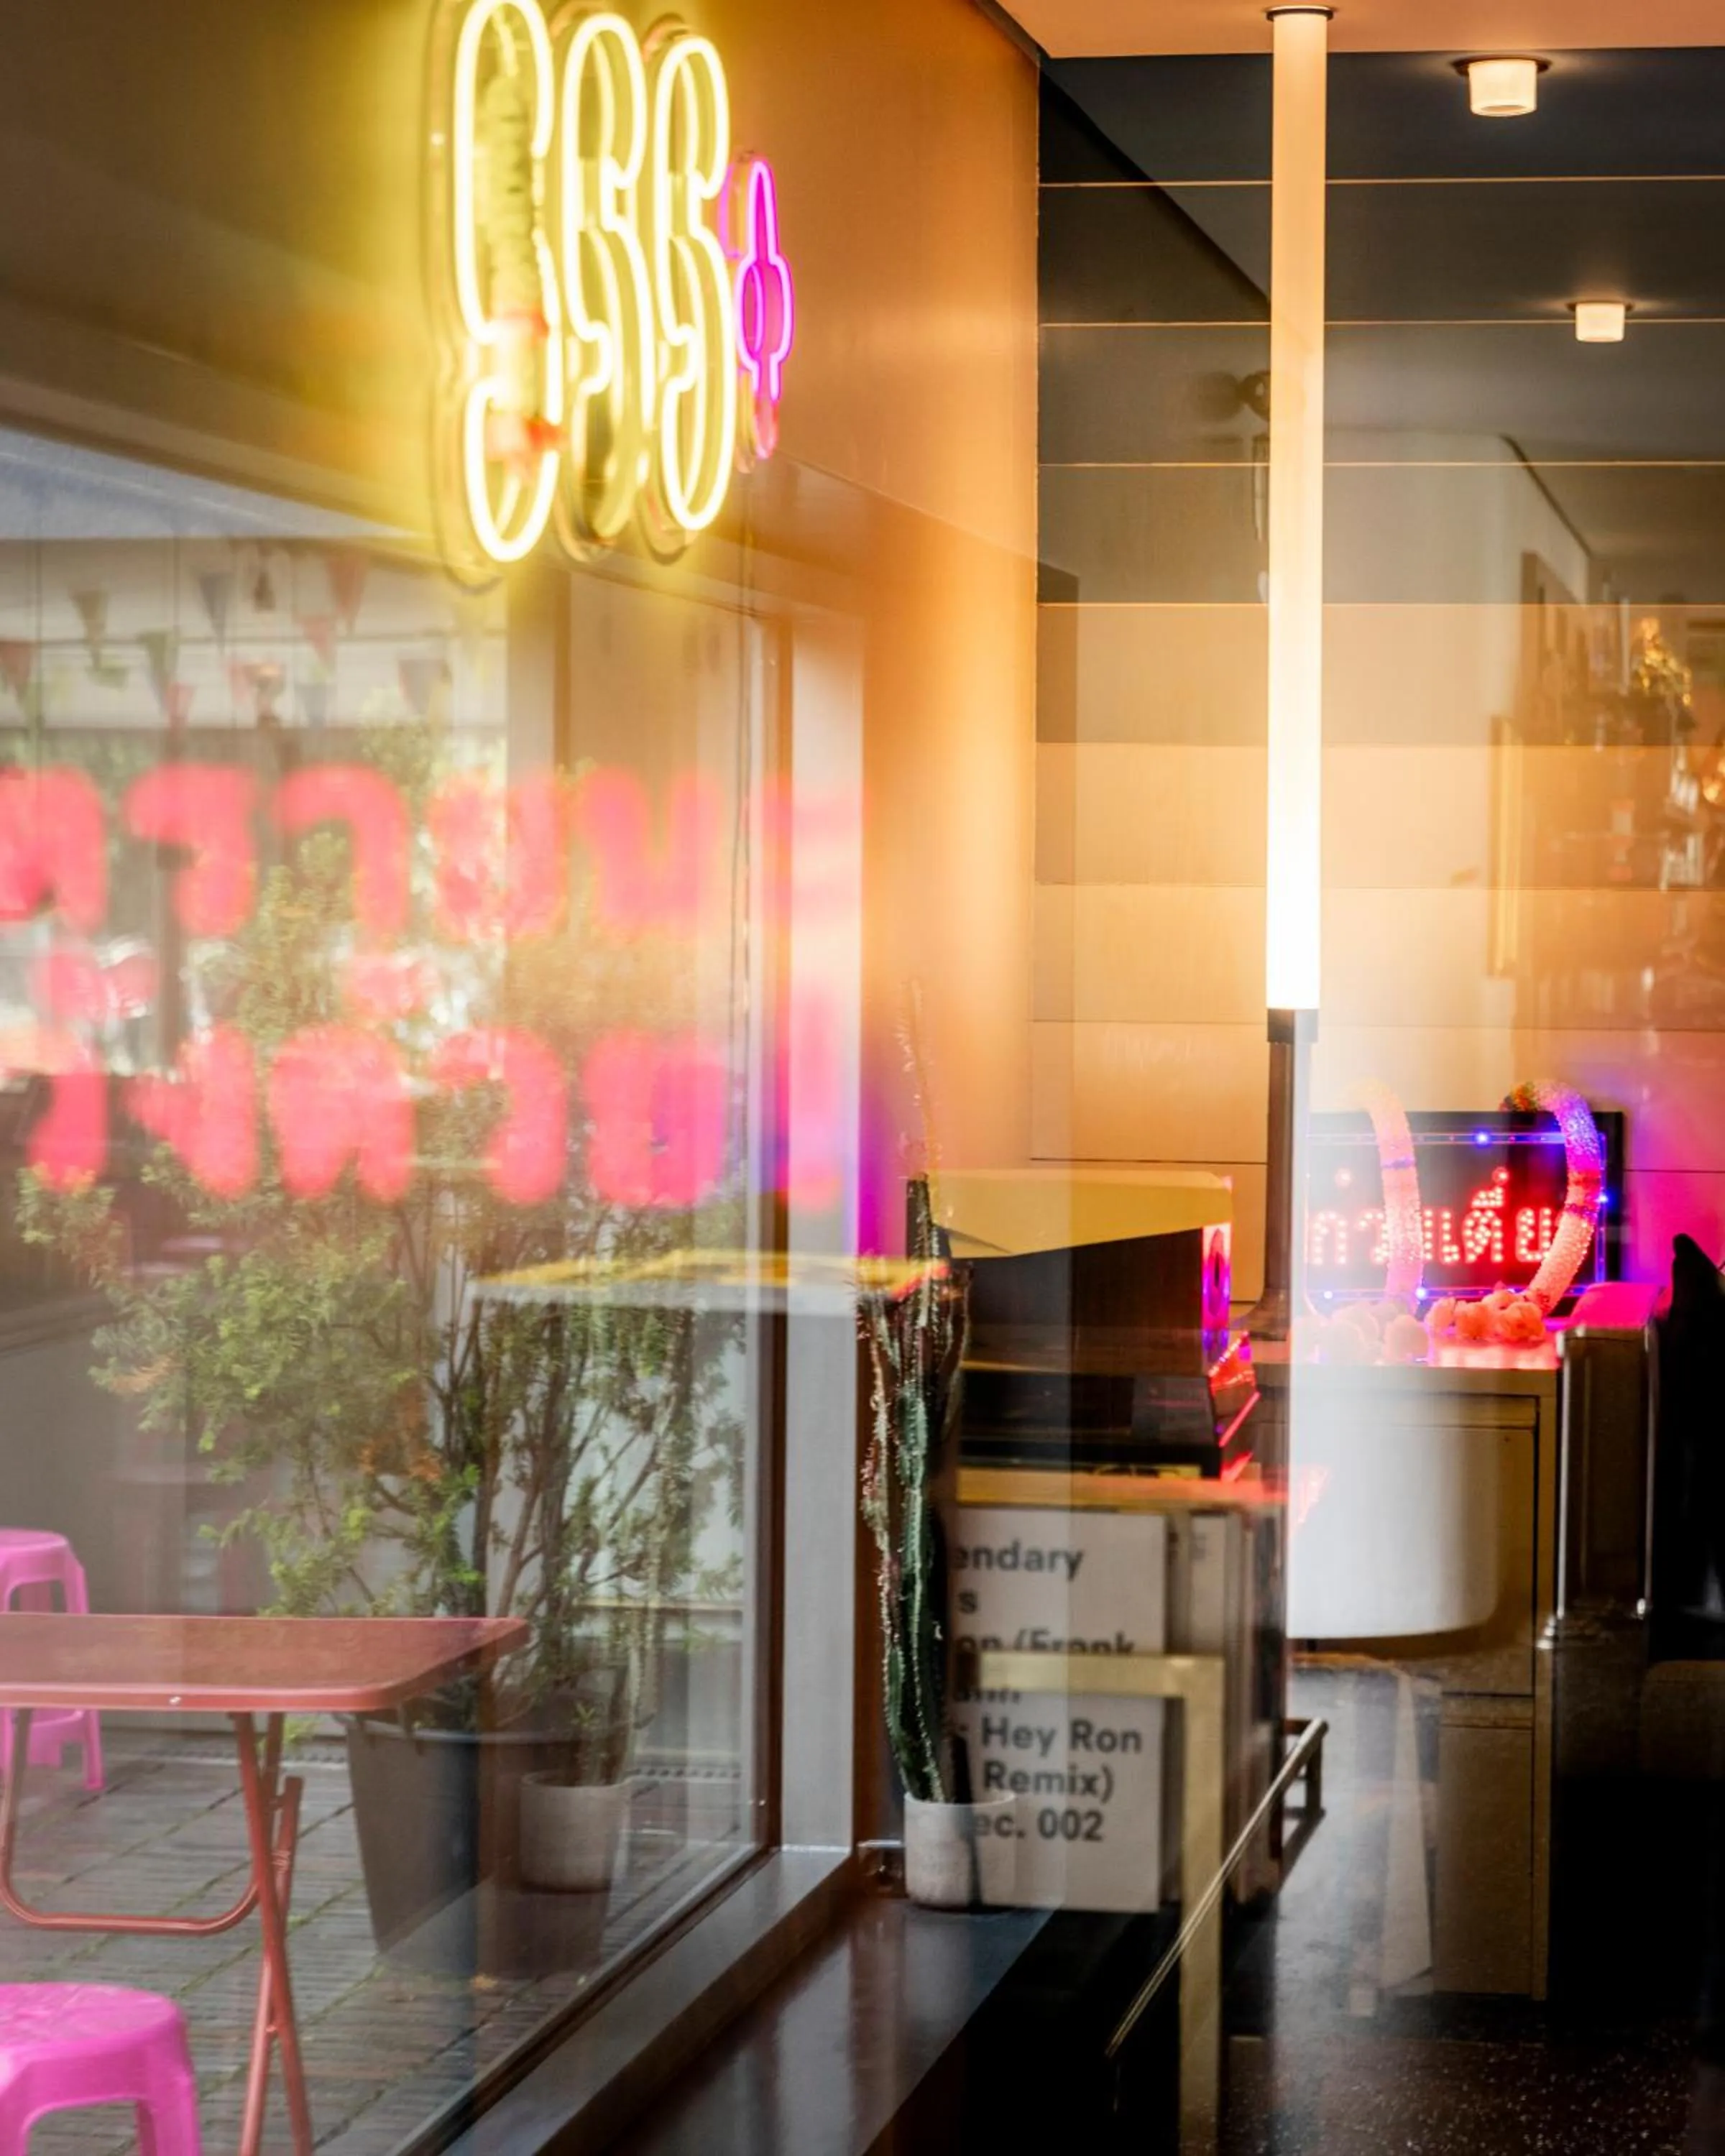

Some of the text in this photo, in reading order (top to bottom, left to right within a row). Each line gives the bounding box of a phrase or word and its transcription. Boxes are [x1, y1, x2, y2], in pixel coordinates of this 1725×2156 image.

[982, 1716, 1142, 1758] Hey Ron
[984, 1760, 1115, 1805] Remix)
[1037, 1807, 1105, 1843] 002
